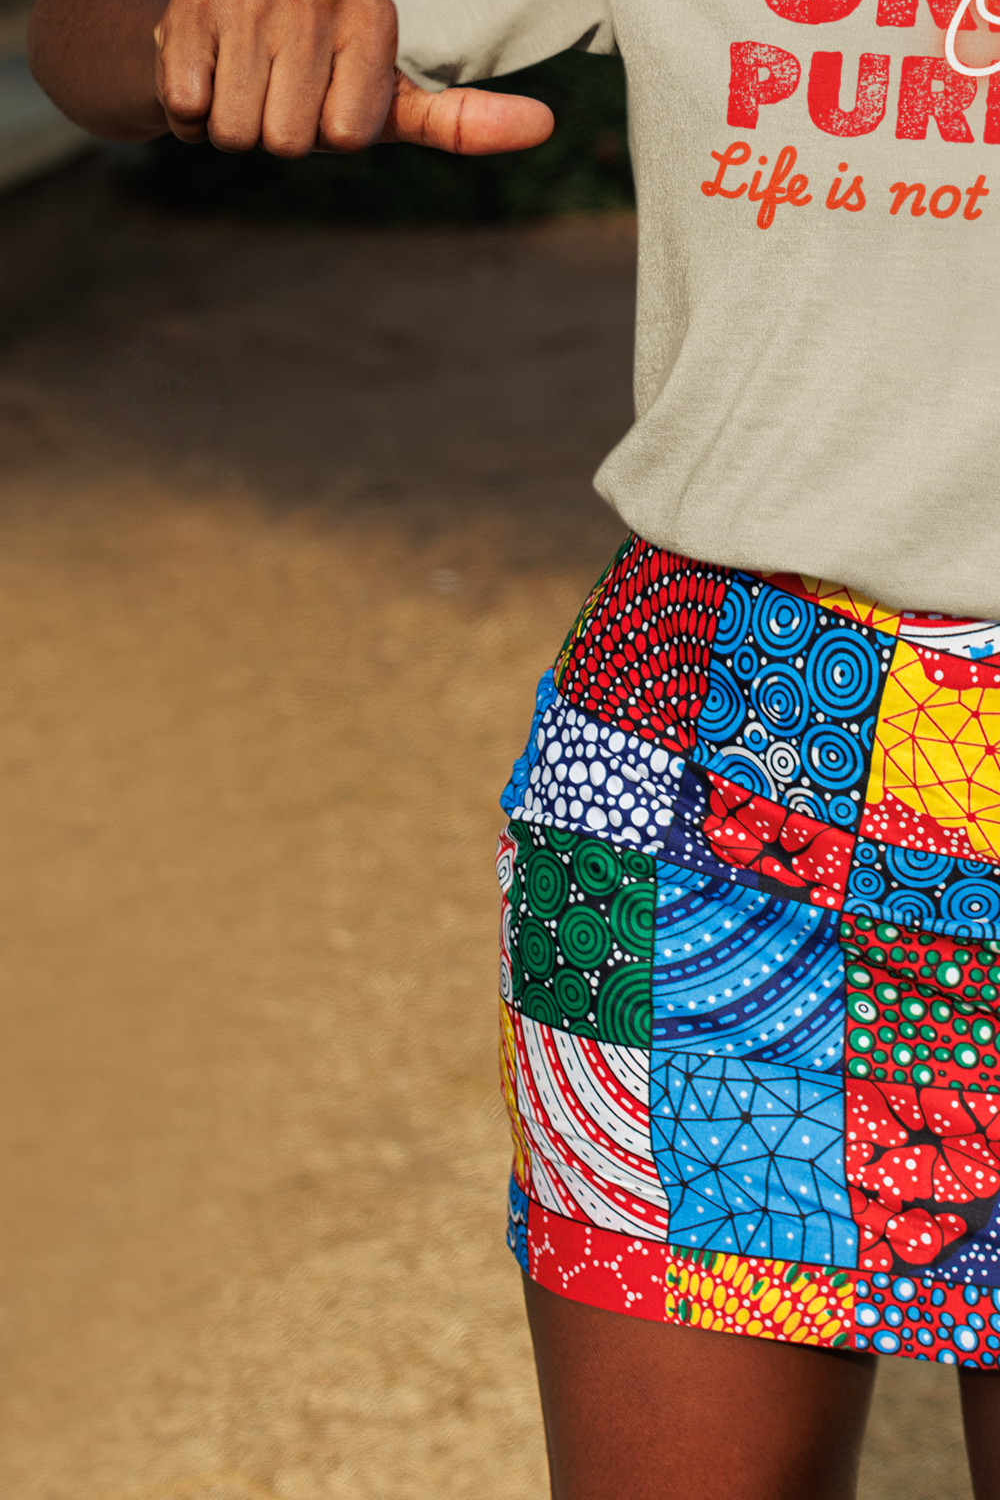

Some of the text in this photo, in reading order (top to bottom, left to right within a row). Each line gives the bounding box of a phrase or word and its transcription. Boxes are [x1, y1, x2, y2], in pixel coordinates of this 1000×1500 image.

[700, 141, 813, 231] Life
[825, 161, 867, 213] is
[889, 174, 990, 221] not
